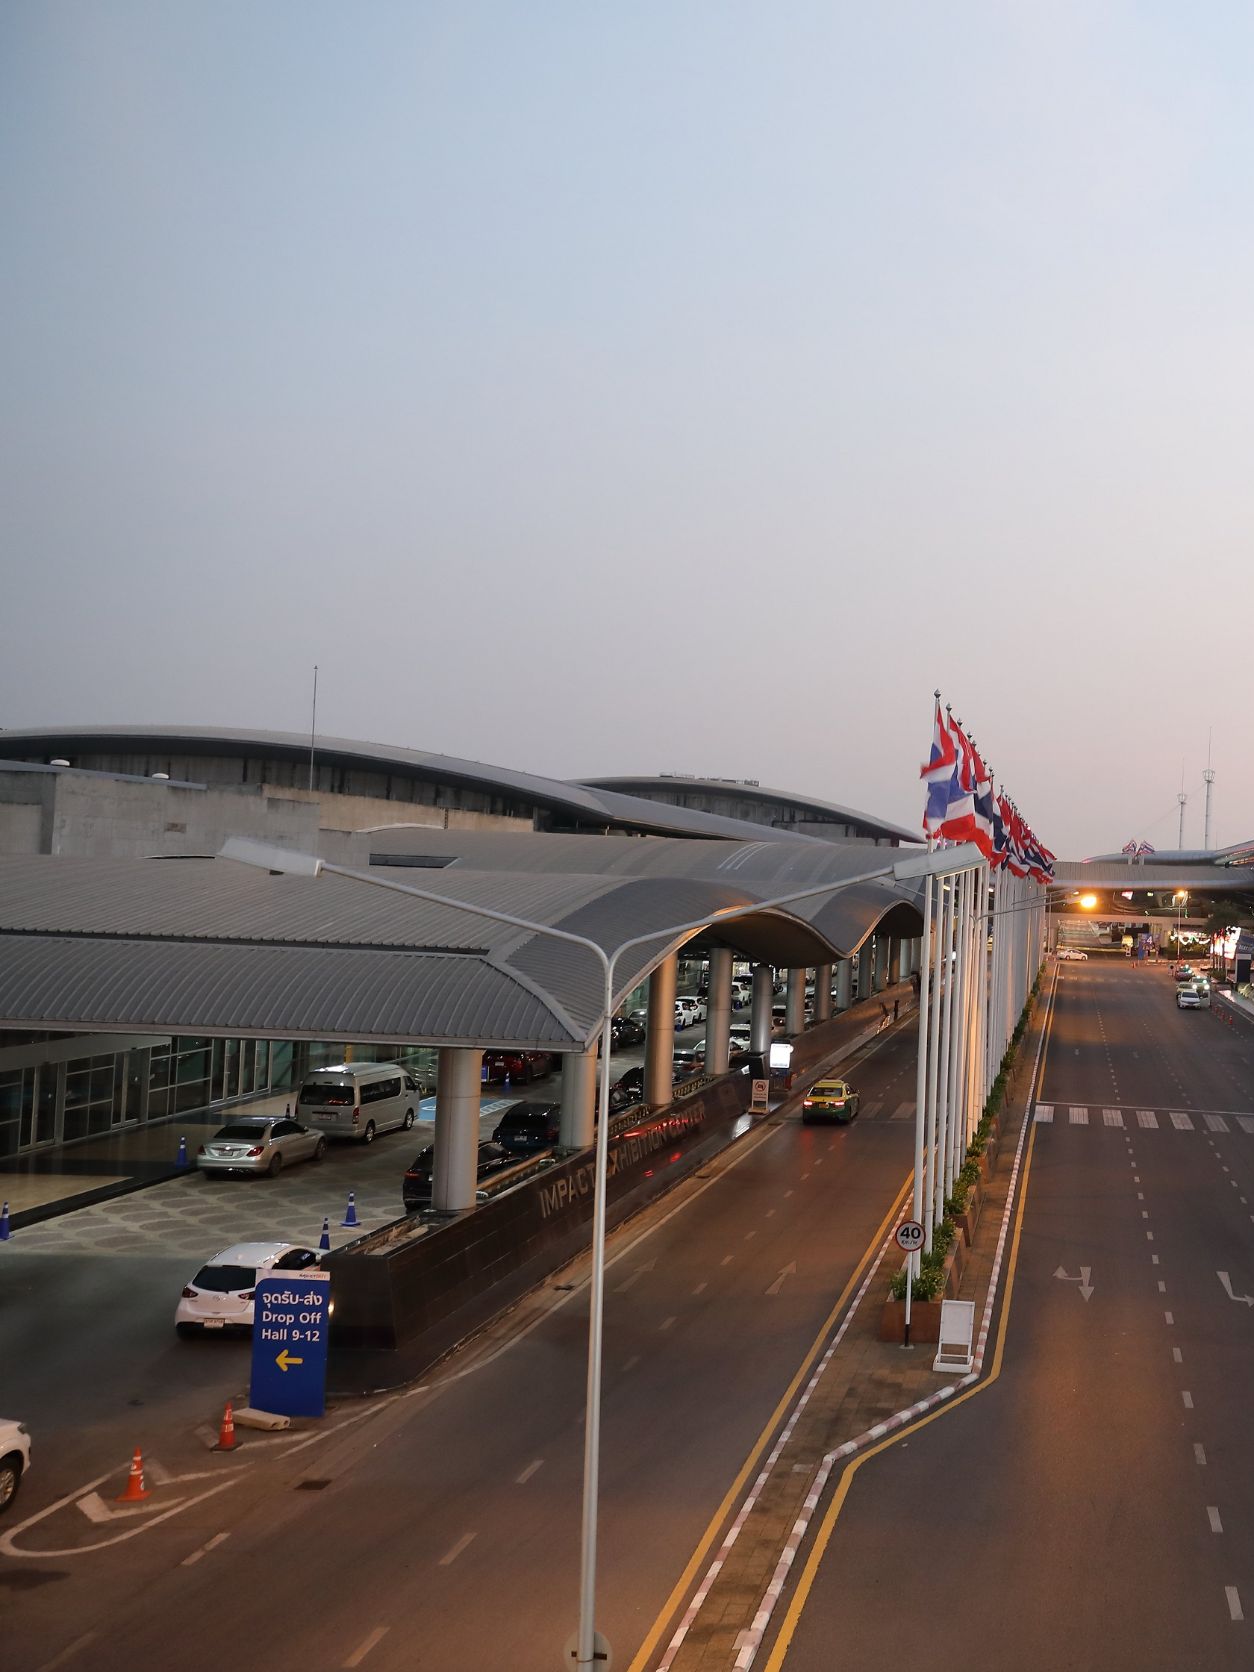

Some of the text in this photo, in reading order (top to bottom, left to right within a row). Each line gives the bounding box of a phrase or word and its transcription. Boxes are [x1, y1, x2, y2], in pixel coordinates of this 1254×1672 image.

[539, 1165, 596, 1218] IMPACT
[604, 1128, 668, 1177] XHIBITION
[900, 1226, 921, 1239] 40
[262, 1291, 323, 1308] จุดรับ-ส่ง
[262, 1311, 321, 1325] Drop Off
[262, 1328, 320, 1341] Hall 9-12
